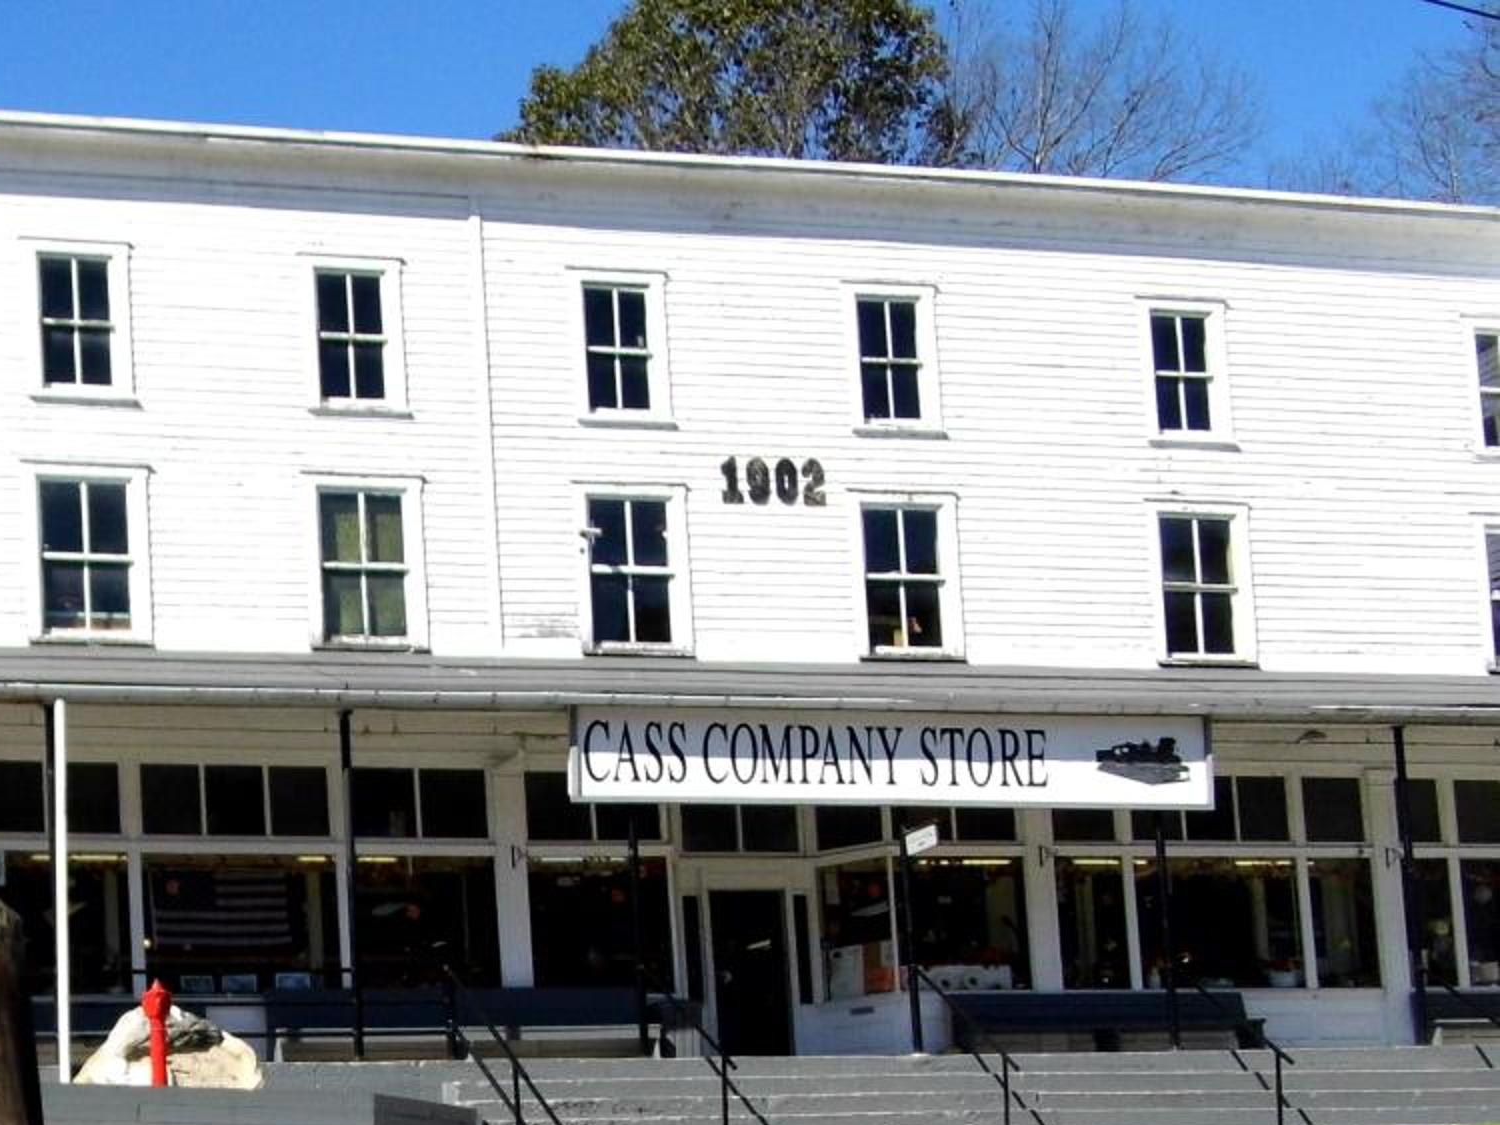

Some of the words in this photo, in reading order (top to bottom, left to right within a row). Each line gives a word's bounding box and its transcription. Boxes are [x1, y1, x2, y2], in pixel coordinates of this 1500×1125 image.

[720, 455, 827, 507] 1902
[583, 719, 688, 783] CASS
[702, 721, 903, 785] COMPANY
[919, 725, 1049, 787] STORE
